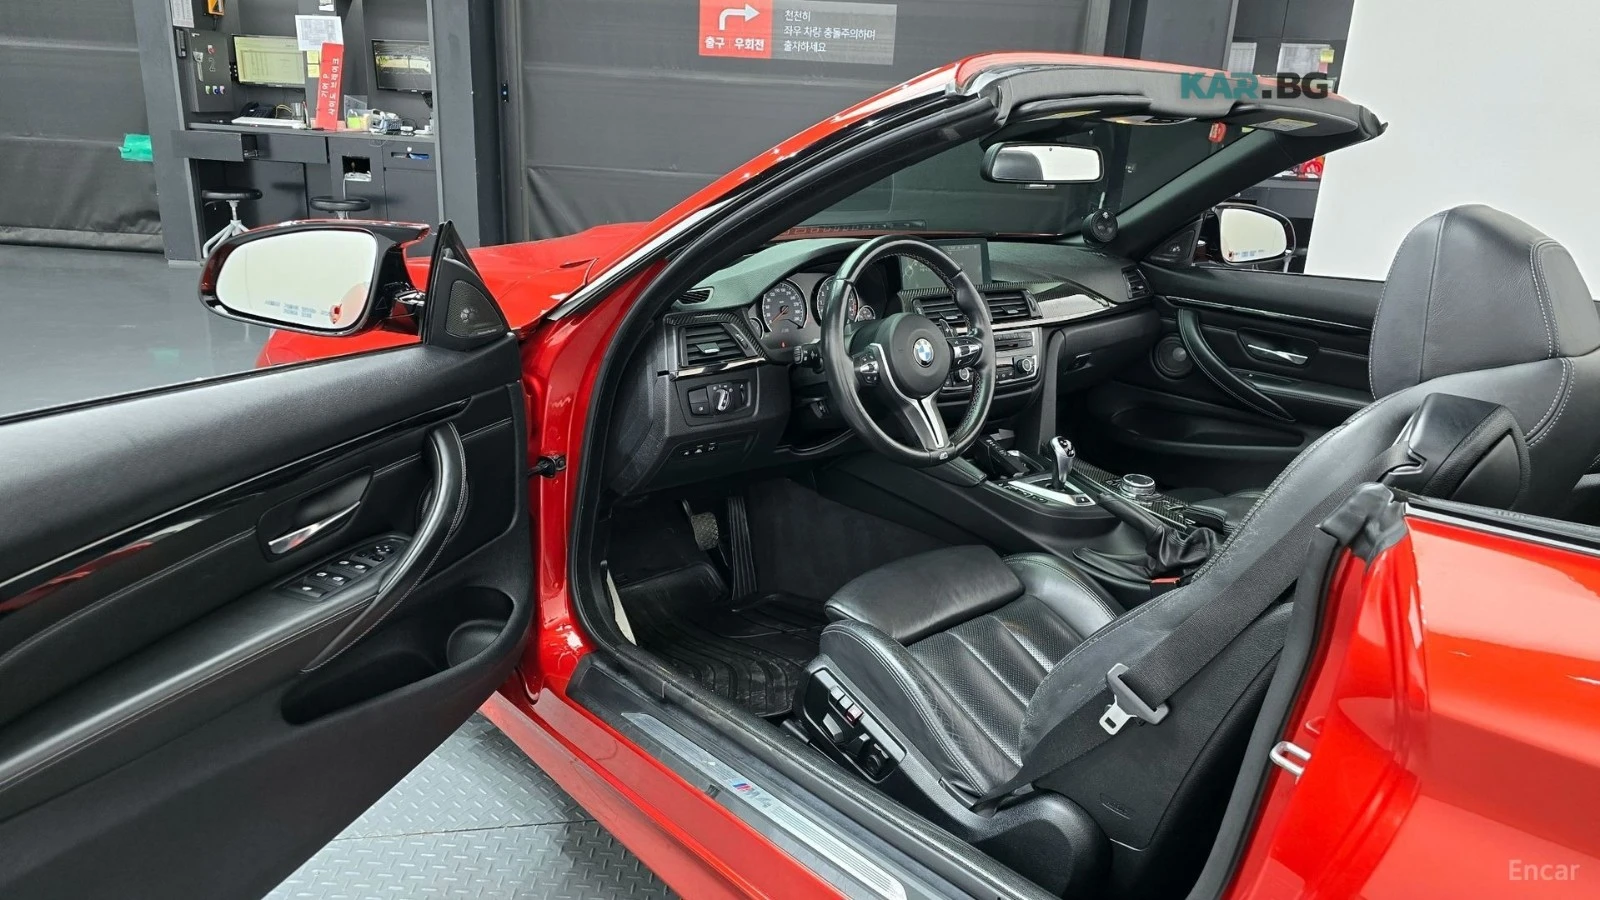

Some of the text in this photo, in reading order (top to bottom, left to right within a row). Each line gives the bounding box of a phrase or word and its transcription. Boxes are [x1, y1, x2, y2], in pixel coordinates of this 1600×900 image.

[784, 9, 811, 22] 천천히
[783, 25, 876, 41] 좌우 차량 충돌주의하며
[705, 36, 765, 51] 출구 우회전
[784, 40, 827, 53] 출차하세요
